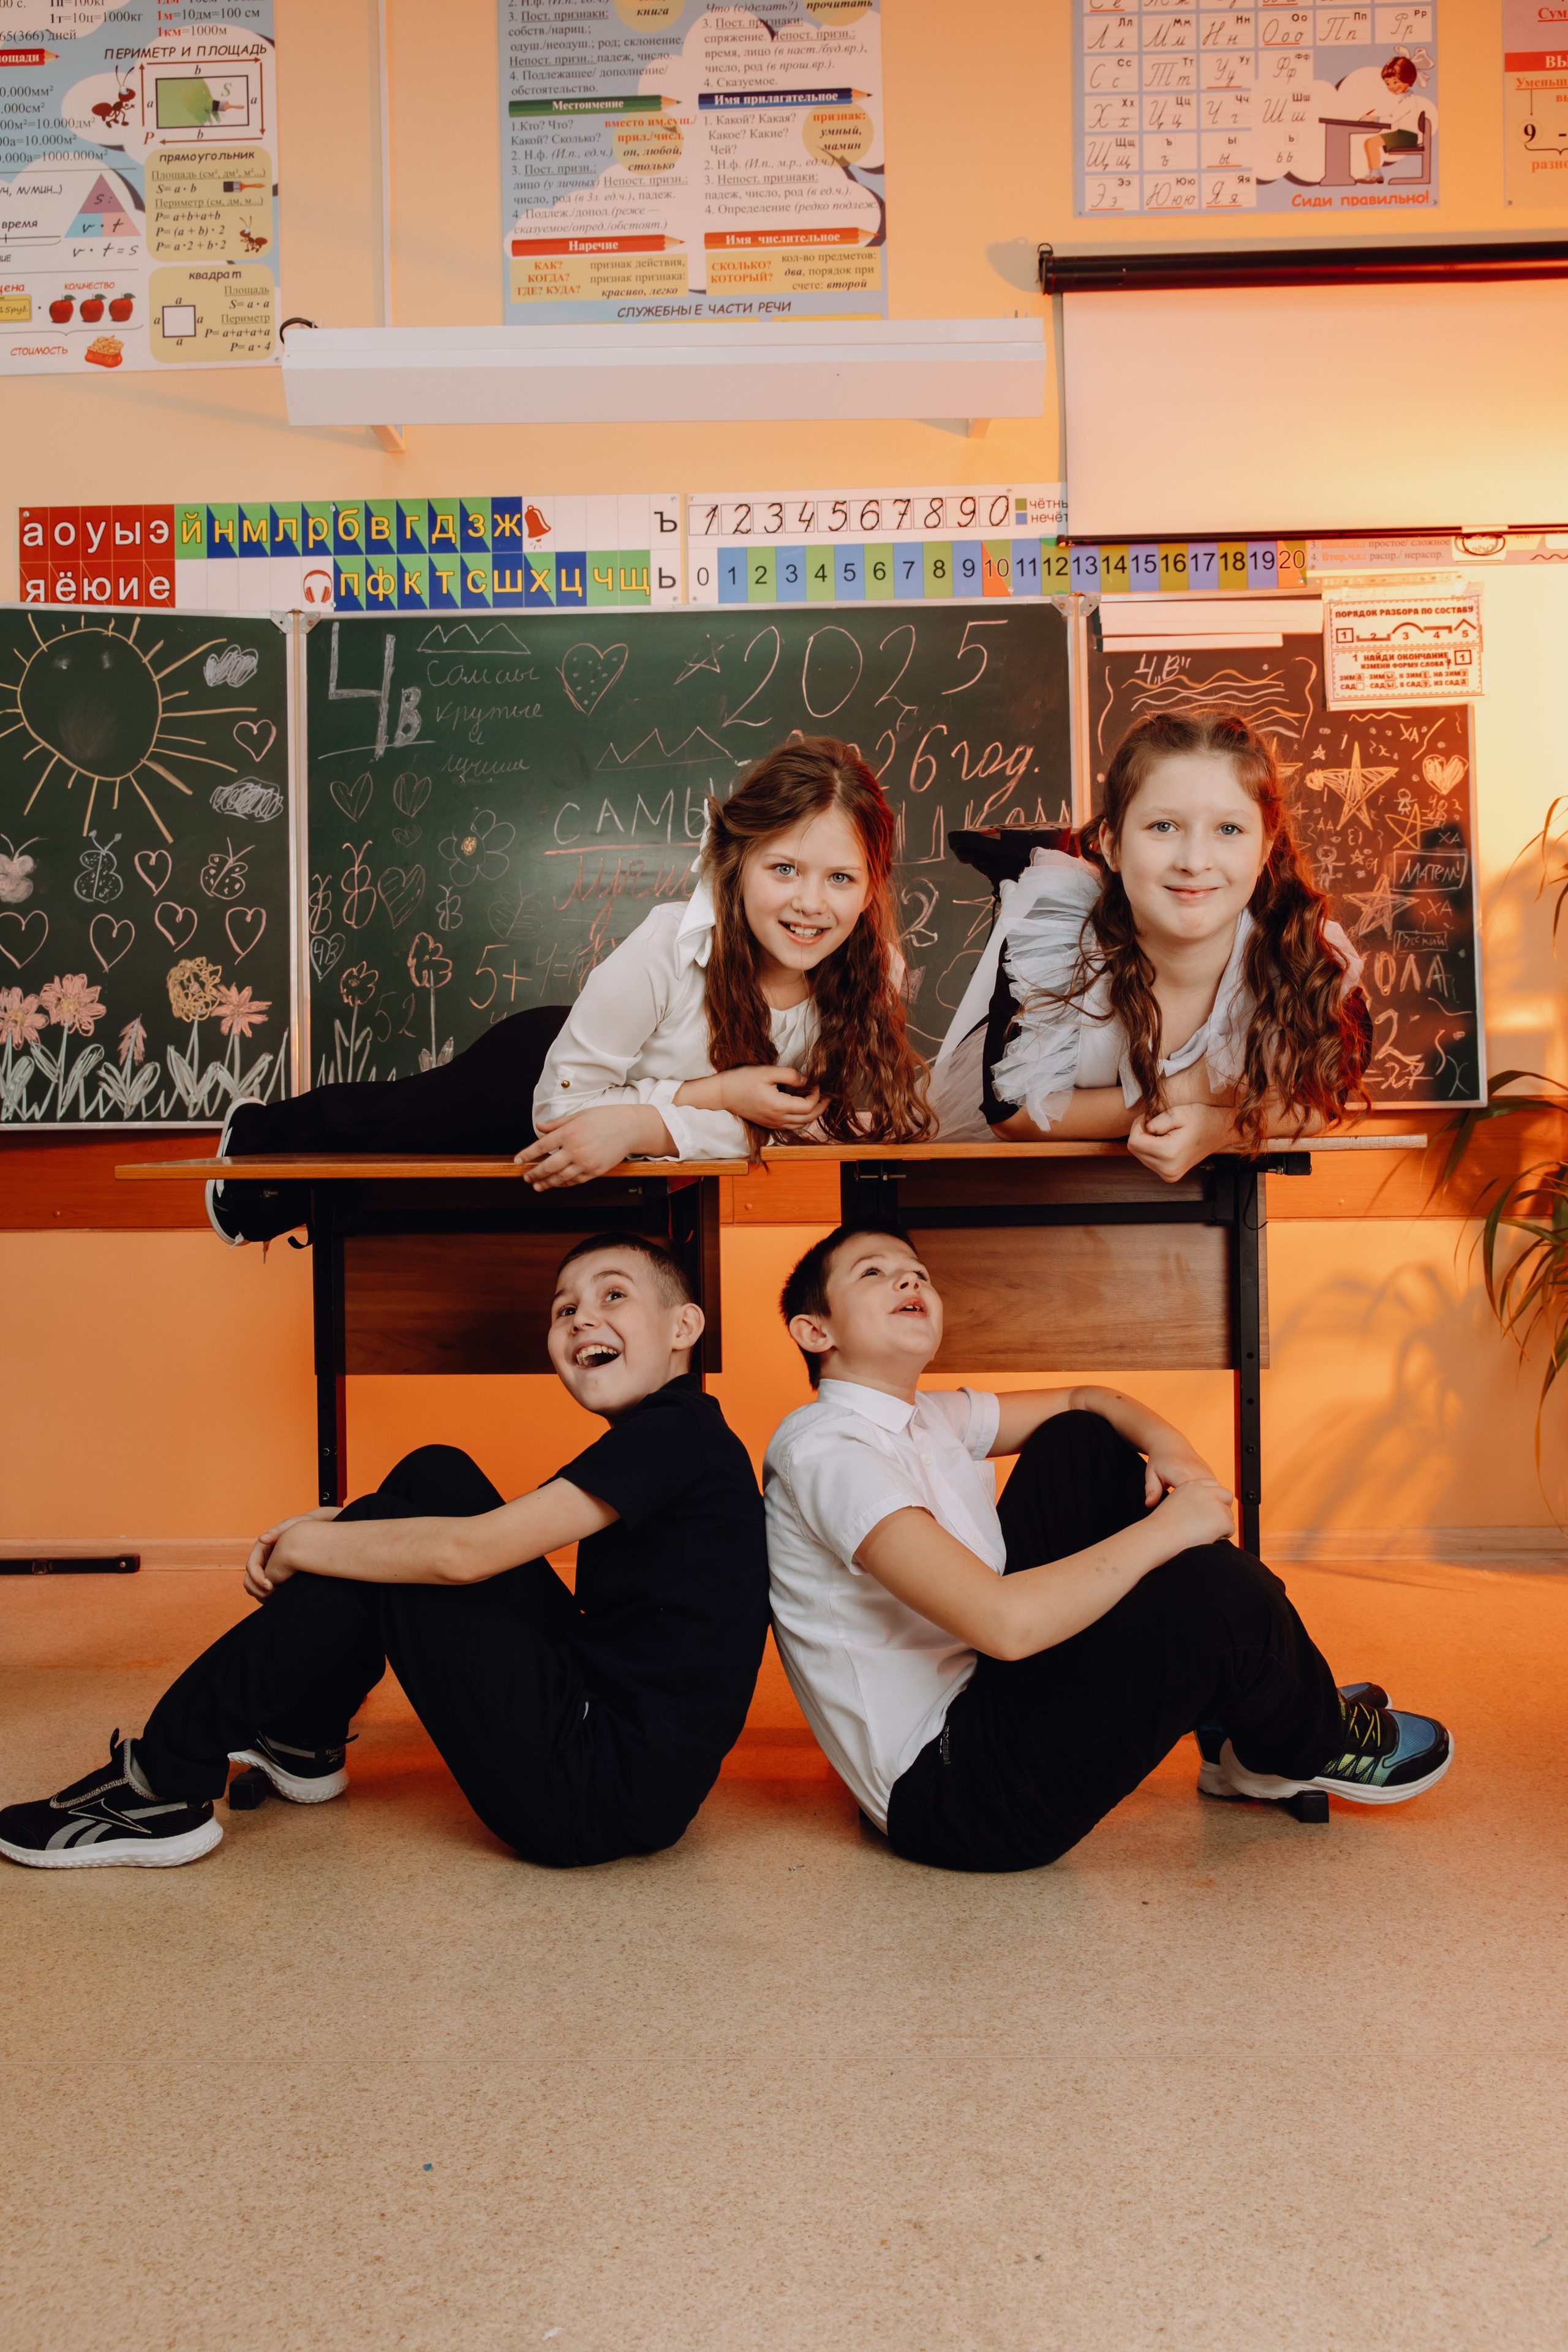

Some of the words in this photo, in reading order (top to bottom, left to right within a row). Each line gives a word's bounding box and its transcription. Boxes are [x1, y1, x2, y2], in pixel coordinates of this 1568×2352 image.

[806, 1, 873, 11] прочитать
[245, 9, 260, 18] см
[554, 10, 609, 21] признаки:
[637, 7, 669, 17] книга
[48, 29, 77, 41] дней
[704, 34, 767, 45] спряжение.
[624, 37, 684, 47] склонение.
[105, 46, 176, 59] ПЕРИМЕТР
[182, 47, 191, 56] И
[197, 44, 267, 57] ПЛОЩАДЬ
[744, 49, 771, 58] лицо
[0, 54, 39, 64] ощади
[717, 77, 778, 88] Сказуемое.
[511, 85, 598, 96] обстоятельство.
[714, 95, 740, 106] Имя
[744, 92, 839, 105] прилагательное
[552, 100, 624, 111] Местоимение
[605, 119, 644, 128] вместо
[716, 115, 755, 126] Какой?
[759, 113, 796, 124] Какая?
[813, 113, 866, 123] признак:
[548, 119, 573, 130] Что?
[709, 129, 746, 141] Какое?
[750, 129, 789, 139] Какие?
[820, 127, 862, 138] умный,
[1524, 124, 1536, 143] 9
[511, 135, 549, 146] Какой?
[552, 133, 601, 144] Сколько?
[710, 145, 737, 155] Чей?
[159, 150, 255, 164] прямоугольник
[628, 162, 675, 171] столько
[151, 170, 196, 181] Площадь
[155, 198, 203, 209] Периметр
[1292, 194, 1332, 208] Сиди
[1341, 190, 1430, 207] правильно!
[718, 203, 791, 215] Определение
[2, 221, 37, 232] время
[726, 235, 752, 245] Имя
[758, 233, 840, 244] числительное
[569, 241, 619, 252] Наречие
[782, 254, 815, 263] кол-во
[818, 252, 876, 263] предметов:
[534, 261, 563, 270] КАК?
[590, 262, 631, 272] признак
[635, 259, 685, 270] действия,
[712, 261, 772, 271] СКОЛЬКО?
[189, 271, 242, 282] квадрат
[809, 266, 851, 277] порядок
[854, 266, 874, 276] при
[527, 273, 570, 284] КОГДА?
[636, 273, 686, 284] признака:
[710, 272, 773, 284] КОТОРЫЙ?
[827, 280, 867, 290] второй
[224, 287, 270, 298] Площадь
[518, 287, 543, 297] ГДЕ?
[546, 285, 581, 295] КУДА?
[601, 288, 646, 299] красиво,
[649, 288, 678, 296] легко
[708, 303, 753, 314] ЧАСТИ
[758, 302, 791, 313] РЕЧИ
[221, 314, 270, 325] Периметр
[704, 505, 718, 535] 1
[733, 504, 752, 534] 2
[764, 503, 783, 532] 3
[799, 502, 815, 532] 4
[829, 501, 846, 531] 5
[860, 500, 880, 530] 6
[892, 499, 911, 529] 7
[924, 498, 943, 529] 8
[957, 497, 976, 527] 9
[990, 496, 1009, 527] 0
[697, 567, 709, 586] 0
[728, 567, 736, 585] 1
[755, 566, 768, 584] 2
[785, 565, 798, 583] 3
[815, 564, 827, 582] 4
[843, 563, 856, 582] 5
[873, 562, 886, 581] 6
[902, 561, 916, 579] 7
[933, 560, 946, 578] 8
[962, 559, 976, 578] 9
[984, 558, 1009, 578] 10
[1016, 558, 1037, 576] 11
[1043, 557, 1068, 576] 12
[1072, 556, 1098, 575] 13
[1102, 556, 1127, 574] 14
[1131, 554, 1157, 573] 15
[1161, 553, 1186, 572] 16
[1190, 553, 1215, 571] 17
[1219, 552, 1246, 571] 18
[1250, 551, 1275, 570] 19
[1279, 550, 1305, 569] 20
[1335, 609, 1378, 618] ПОРЯДОК
[1380, 608, 1419, 616] РАЗБОРА
[1364, 653, 1394, 662] НАЙДИ
[1397, 652, 1449, 661] ОКОНЧАНИЕ
[723, 619, 1009, 728] 2025
